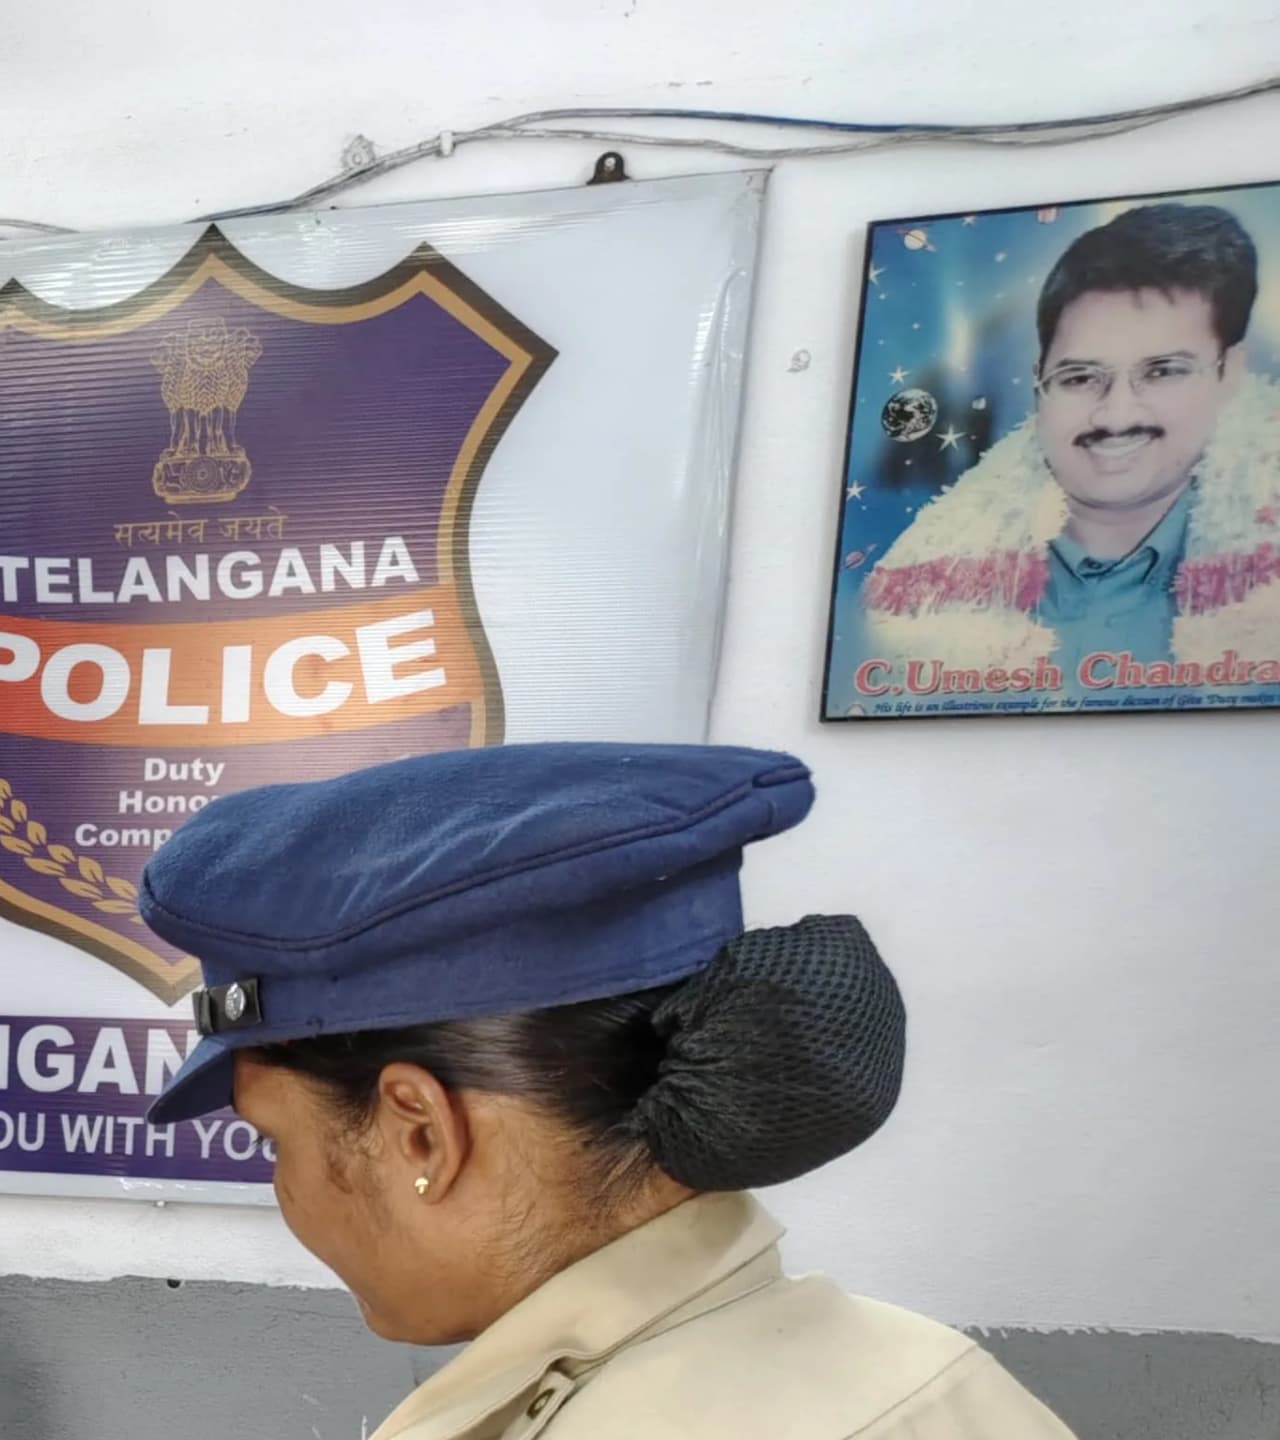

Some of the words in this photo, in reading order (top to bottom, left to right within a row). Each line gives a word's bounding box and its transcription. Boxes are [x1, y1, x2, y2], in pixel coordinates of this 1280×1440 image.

[219, 507, 289, 545] जयते
[855, 659, 1062, 696] C.Umesh
[1078, 650, 1280, 689] Chandra
[144, 758, 226, 786] Duty
[118, 791, 219, 813] Hono
[75, 824, 174, 851] Comp
[61, 1113, 174, 1157] WITH
